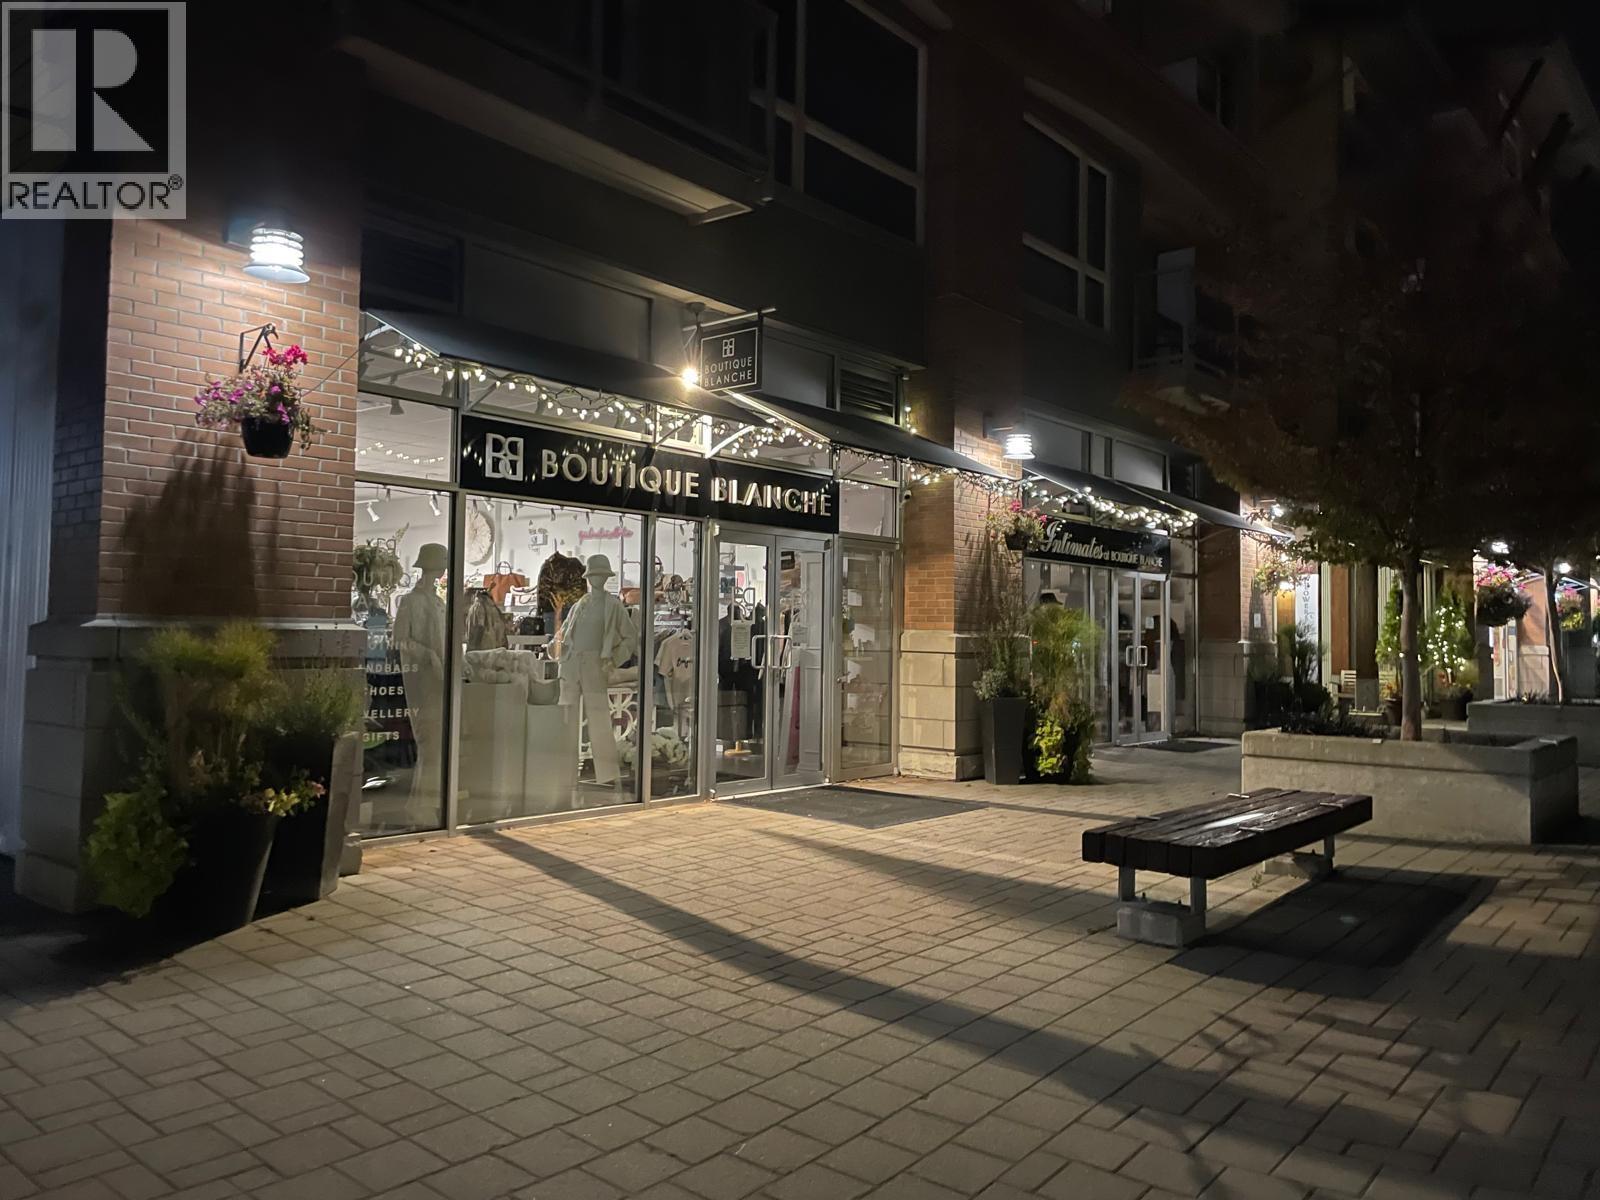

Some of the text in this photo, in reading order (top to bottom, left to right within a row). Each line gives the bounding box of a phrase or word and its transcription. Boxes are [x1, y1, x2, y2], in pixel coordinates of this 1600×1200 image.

[704, 356, 752, 374] BOUTIQUE
[704, 369, 752, 387] BLANCHE
[541, 449, 831, 516] BOUTIQUE BLANCHE
[1040, 520, 1104, 560] Intimates
[366, 663, 418, 673] NDBAGS
[364, 686, 404, 696] HOES
[363, 708, 420, 719] ELLERY
